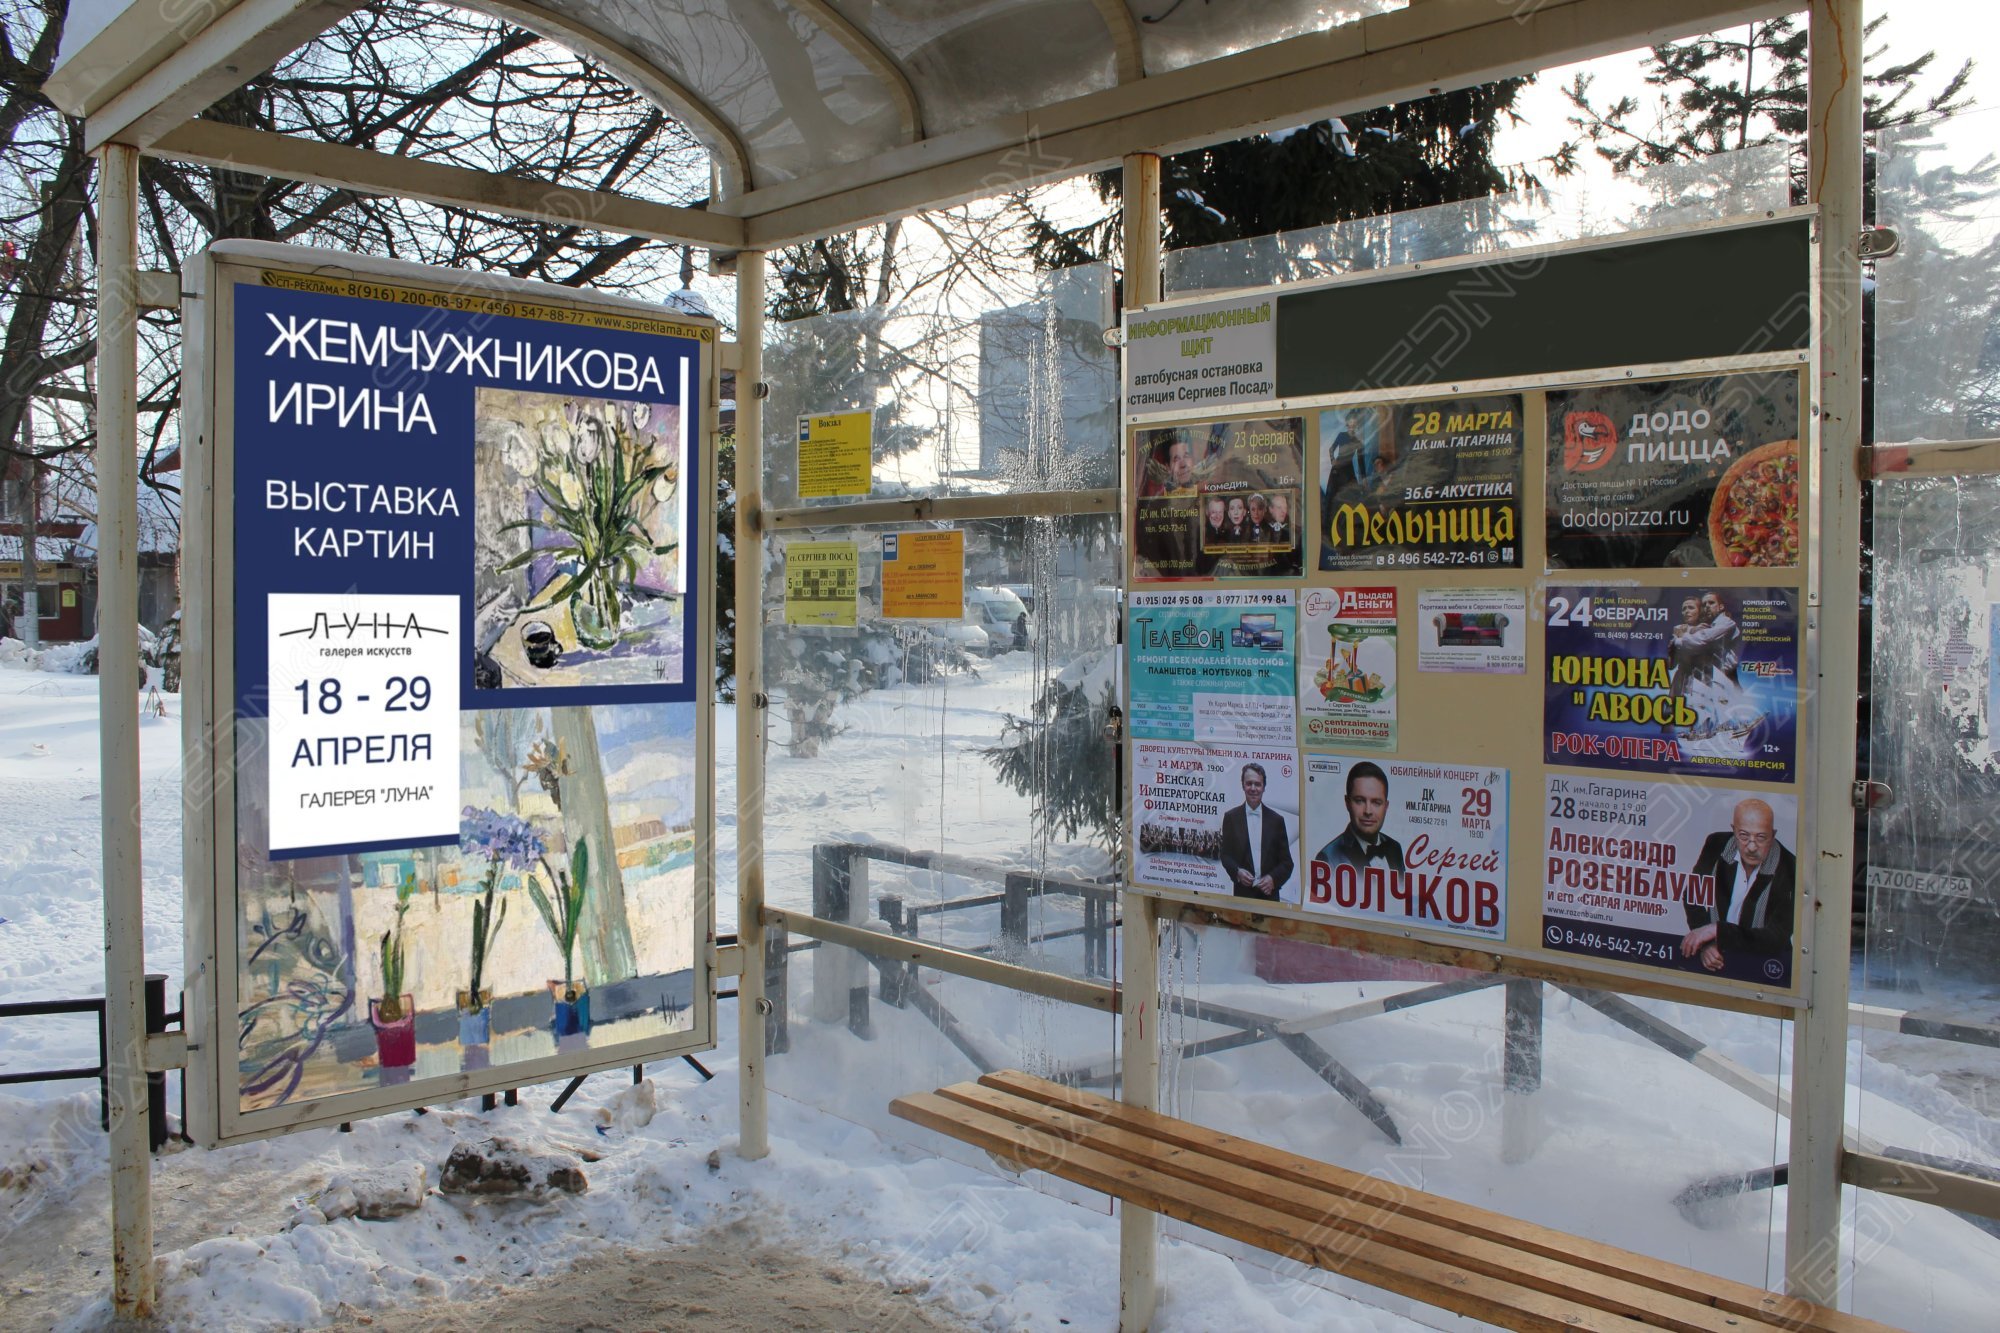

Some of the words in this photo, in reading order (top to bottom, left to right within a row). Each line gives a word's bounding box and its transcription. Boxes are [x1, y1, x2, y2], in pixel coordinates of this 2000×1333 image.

[348, 283, 395, 302] 8(916)
[481, 301, 516, 317] (496)
[521, 306, 584, 324] 547-88-77
[594, 314, 697, 338] www.spreklama.ru
[1128, 302, 1271, 339] ИНФОРМАЦИОННЫЙ
[264, 312, 665, 394] ЖЕМЧУЖНИКОВА
[1181, 337, 1213, 358] ЩИТ
[1135, 369, 1198, 386] автобусная
[1202, 362, 1262, 378] остановка
[1178, 385, 1226, 402] Сергиев
[1230, 381, 1273, 395] Посад»
[268, 380, 437, 435] ИРИНА
[1410, 412, 1440, 435] 28
[1446, 411, 1512, 432] МАРТА
[1629, 409, 1711, 437] ДОДО
[1235, 432, 1245, 448] 23
[1250, 431, 1294, 450] февраля
[1412, 439, 1427, 450] ДК
[1450, 433, 1512, 448] ГАГАРИНА
[1247, 453, 1276, 465] 18:00
[1628, 439, 1731, 464] ПИЦЦА
[1279, 476, 1294, 484] 16+
[1562, 480, 1598, 491] Доставка
[1600, 479, 1624, 489] пиццы
[1650, 478, 1677, 486] России
[265, 479, 459, 517] ВЫСТАВКА
[1562, 494, 1598, 503] Закажите
[1159, 524, 1187, 532] 542-72-61
[1562, 508, 1689, 531] dodopizza.ru
[294, 527, 434, 559] КАРТИН
[798, 553, 827, 562] СЕРГИЕВ
[829, 552, 853, 561] ПОСАД
[1388, 554, 1394, 564] 8
[1398, 553, 1419, 564] 496
[1424, 552, 1484, 564] 542-72-61
[1342, 592, 1392, 610] ДЕНЬГИ
[1549, 597, 1592, 627] 24
[1594, 607, 1668, 621] ФЕВРАЛЯ
[309, 612, 422, 640] ЛУНА
[1630, 632, 1664, 640] 542-72-61
[320, 646, 363, 657] галерея
[367, 644, 412, 656] искусств
[1169, 656, 1189, 664] ВСЕХ
[1192, 655, 1230, 665] МОДЕЛЕЙ
[1233, 658, 1284, 666] ТЕЛЕФОНОВ
[1148, 667, 1196, 675] ПЛАНШЕТОВ
[1202, 668, 1252, 677] НОУТБУКОВ
[1552, 655, 1670, 688] ЮНОНА
[294, 678, 342, 714] 18
[385, 676, 431, 711] 29
[1590, 692, 1697, 726] АВОСЬ
[1325, 719, 1388, 729] centrzaimov.ru
[292, 734, 432, 767] АПРЕЛЯ
[1140, 745, 1165, 753] ДВОРЕЦ
[1168, 746, 1204, 756] КУЛЬТУРЫ
[1206, 749, 1232, 757] ИМЕНИ
[1252, 751, 1292, 761] ГАГАРИНА
[1552, 732, 1681, 762] РОК-ОПЕРА
[1763, 745, 1780, 753] 12+
[1158, 760, 1167, 768] 14
[1171, 760, 1203, 771] МАРТА
[1207, 764, 1224, 772] 19:00
[1390, 765, 1441, 779] ЮБИЛЕЙНЫЙ
[1444, 768, 1479, 782] КОНЦЕРТ
[1691, 756, 1746, 767] АВТОРСКАЯ
[1748, 760, 1785, 770] ВЕРСИЯ
[1422, 789, 1434, 801] ДК
[1551, 779, 1569, 793] ДК
[300, 788, 375, 808] ГАЛЕРЕЯ
[380, 786, 433, 803] "ЛУНА"
[1461, 787, 1491, 817] 29
[1550, 796, 1575, 819] 28
[1579, 800, 1609, 810] начало
[1462, 818, 1491, 830] МАРТА
[1578, 809, 1646, 826] ФЕВРАЛЯ
[1469, 830, 1484, 839] 19:00
[1405, 834, 1500, 874] Сергей
[1550, 827, 1676, 868] Александр
[1548, 857, 1715, 907] РОЗЕНБАУМ
[1309, 860, 1500, 928] ВОЛЧКОВ
[1557, 893, 1574, 903] его
[1577, 893, 1620, 910] «СТАРАЯ
[1623, 898, 1668, 916] АРМИЯ»
[1547, 906, 1613, 921] www.rozenbaum.ru
[1565, 930, 1674, 960] 8-496-542-72-61
